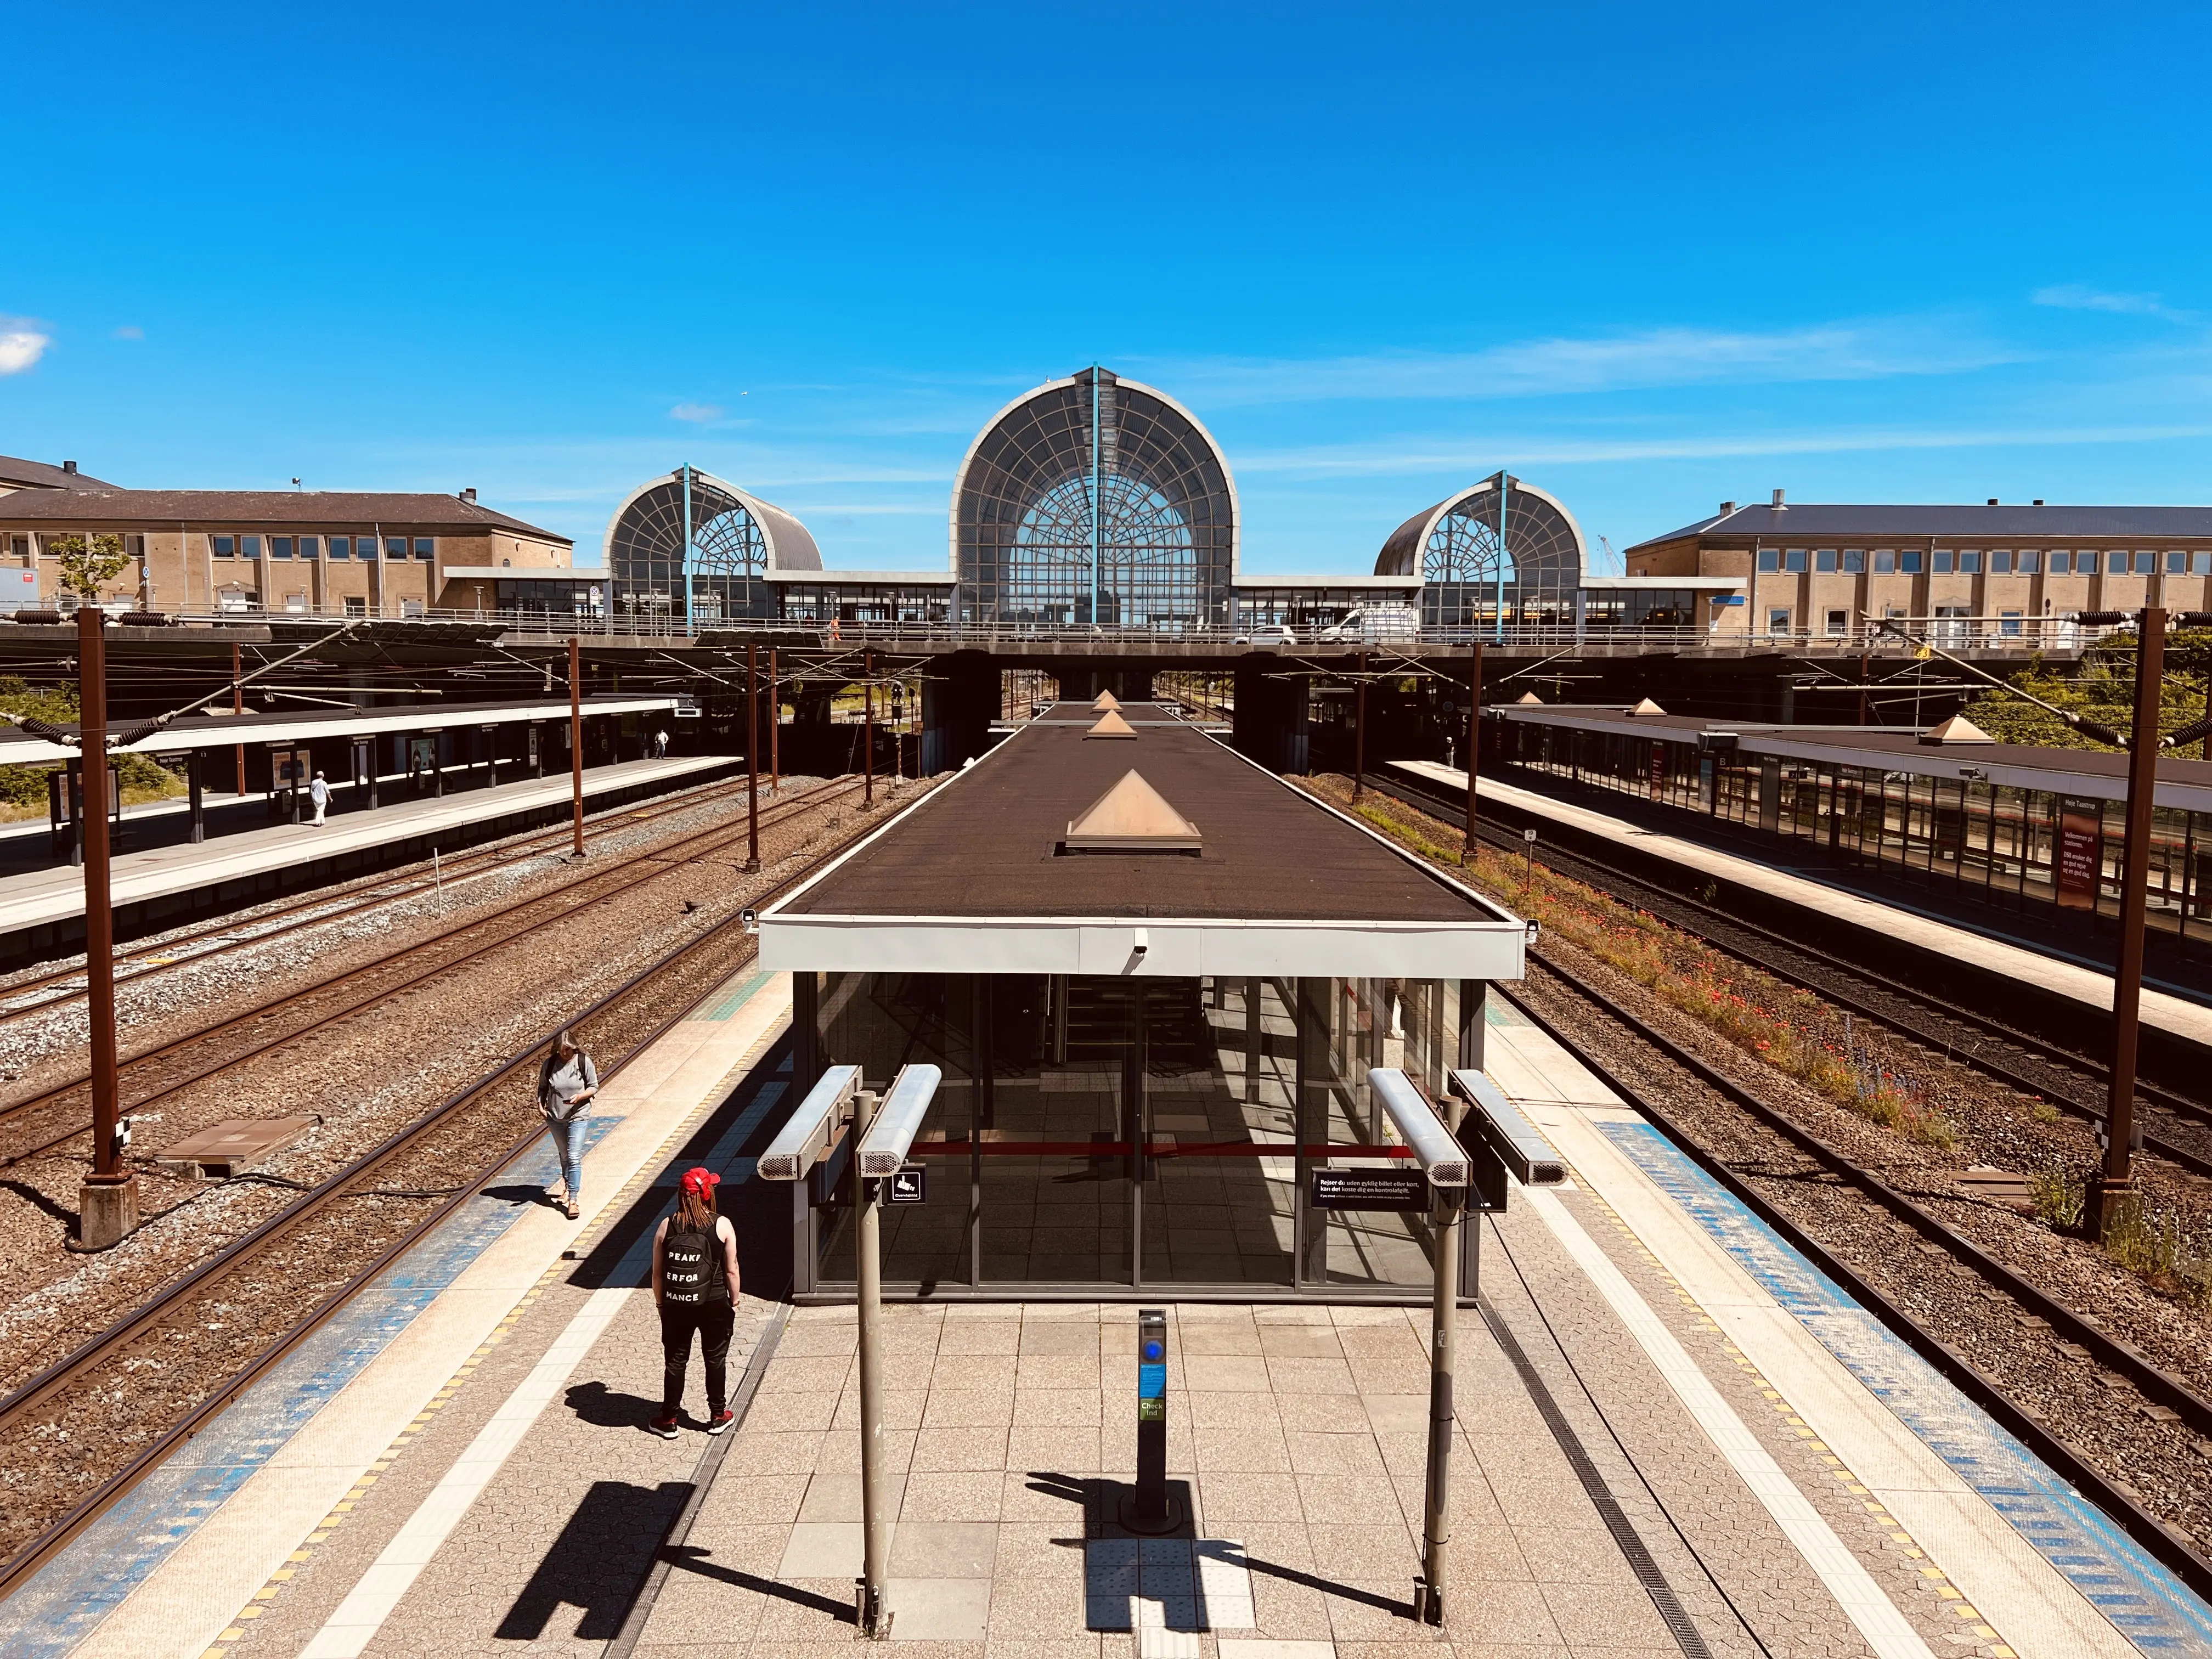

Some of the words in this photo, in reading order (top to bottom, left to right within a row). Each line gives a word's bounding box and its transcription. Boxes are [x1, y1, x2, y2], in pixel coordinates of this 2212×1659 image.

[1719, 758, 1726, 766] B
[667, 1272, 698, 1283] ERFOR
[666, 1291, 699, 1302] MANCE
